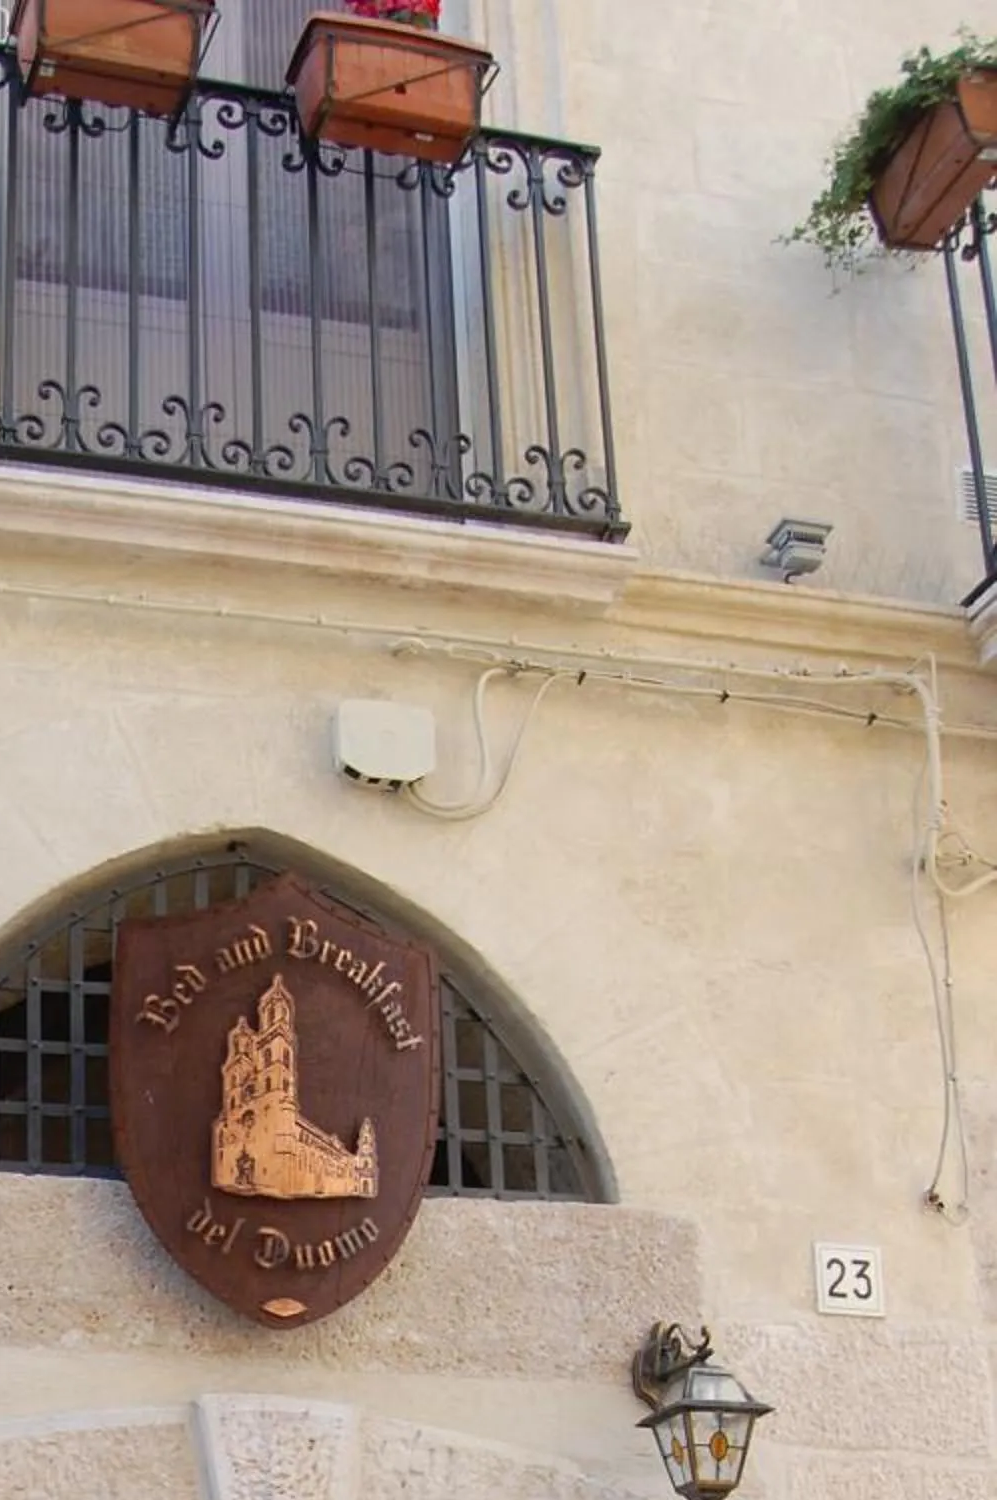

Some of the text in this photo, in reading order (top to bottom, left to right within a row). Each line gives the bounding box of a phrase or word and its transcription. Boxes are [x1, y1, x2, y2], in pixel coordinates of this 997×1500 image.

[136, 916, 424, 1054] Bed and Breakfast
[186, 1196, 381, 1270] del Duomo
[826, 1257, 872, 1300] 23
